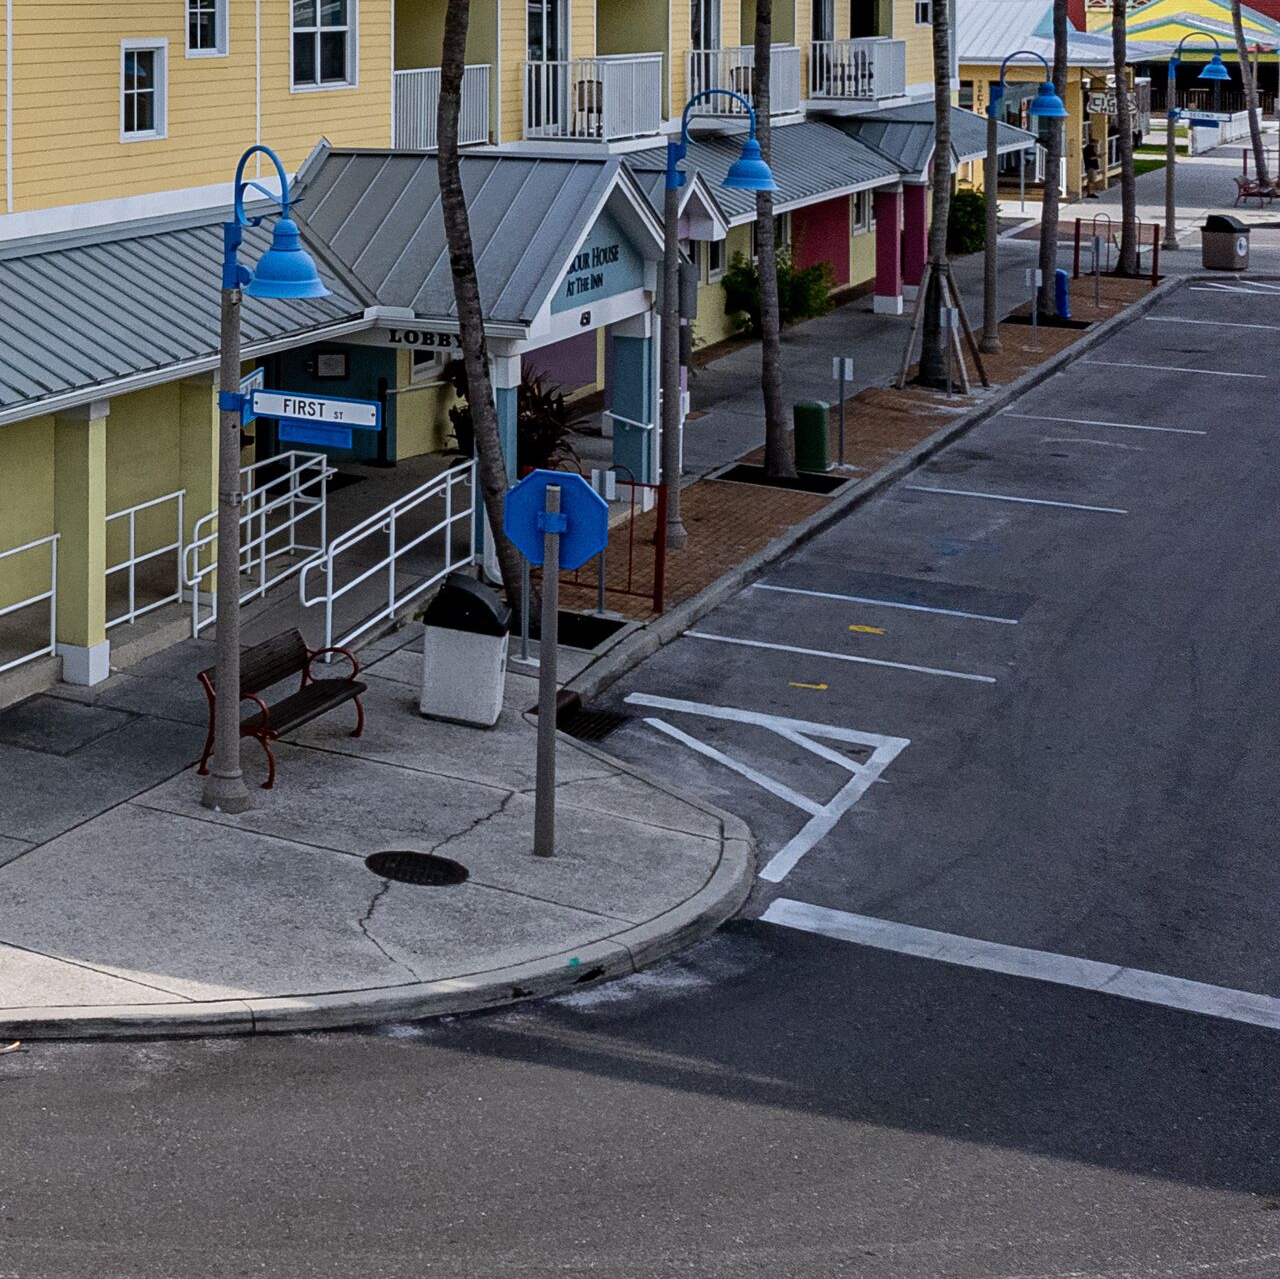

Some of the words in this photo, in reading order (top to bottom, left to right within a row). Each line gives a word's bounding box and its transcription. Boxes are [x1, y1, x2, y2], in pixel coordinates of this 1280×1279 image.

[592, 244, 619, 268] HOUSE
[566, 279, 576, 297] AT
[575, 276, 590, 294] THE
[590, 273, 604, 290] INN
[283, 398, 326, 418] FIRST
[334, 411, 344, 420] ST
